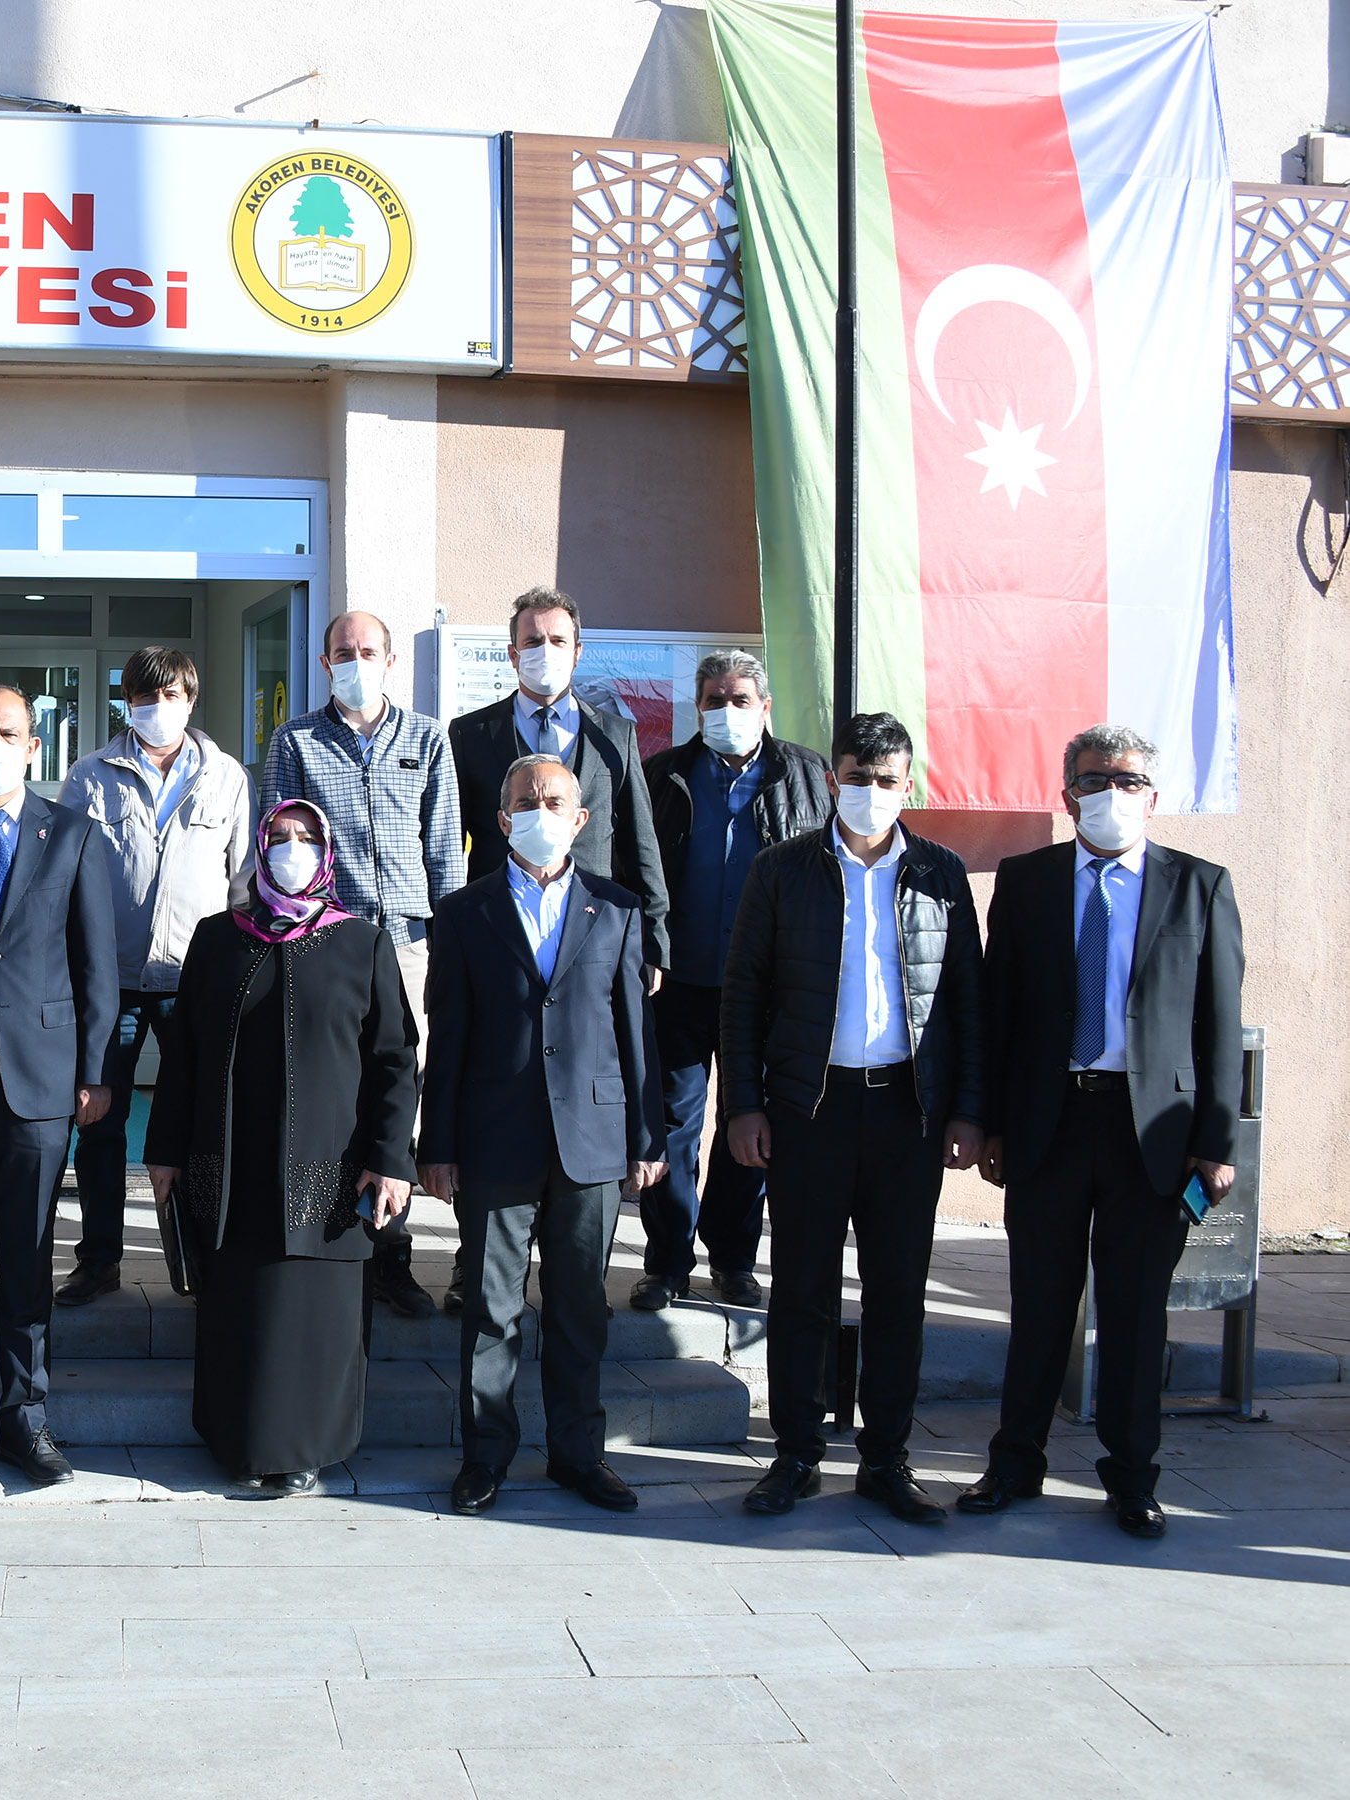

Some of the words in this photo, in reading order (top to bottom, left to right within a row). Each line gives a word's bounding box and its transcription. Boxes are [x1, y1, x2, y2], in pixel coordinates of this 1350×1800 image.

[245, 160, 305, 214] AKÖREN
[311, 158, 404, 220] BELEDİYESİ
[290, 250, 319, 259] Hayatta
[300, 314, 343, 327] 1914
[474, 650, 487, 662] 14
